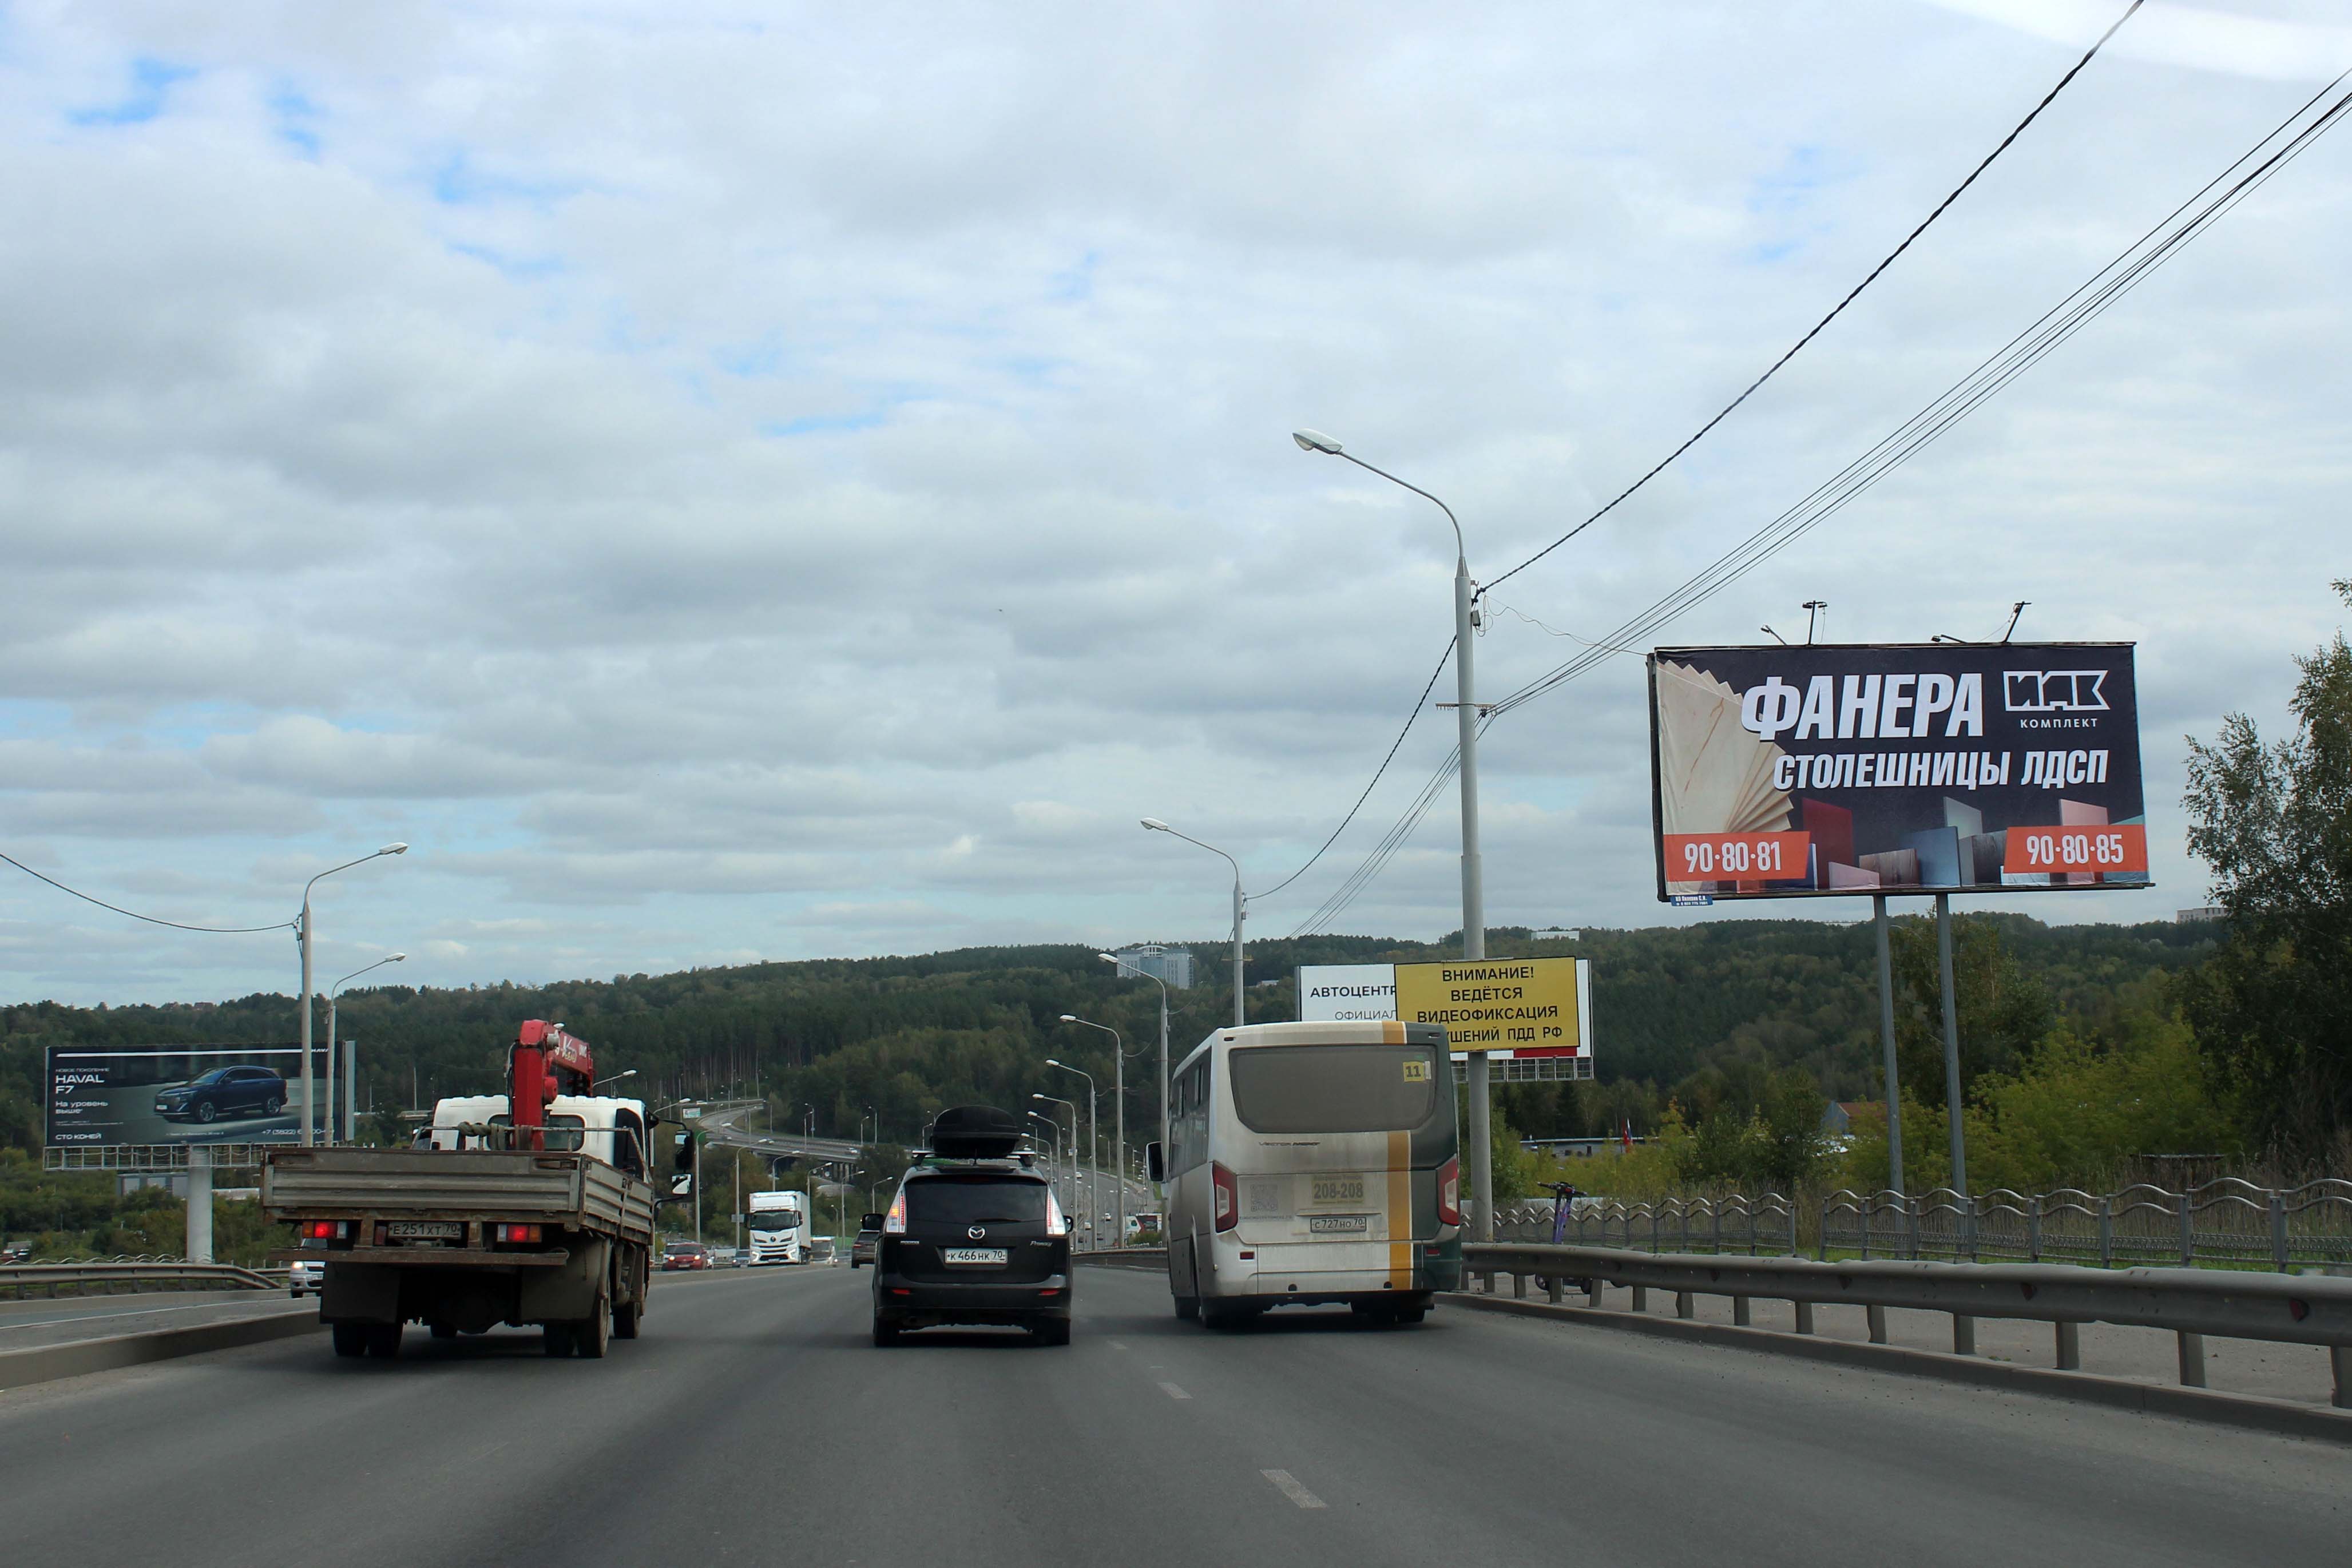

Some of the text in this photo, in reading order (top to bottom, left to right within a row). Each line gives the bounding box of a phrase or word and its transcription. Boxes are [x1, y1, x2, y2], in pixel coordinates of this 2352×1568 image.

[1741, 672, 1984, 741] ФАНЕРА
[2020, 718, 2097, 728] КОМПЛЕКТ
[1773, 749, 2109, 791] СТОЛЕШНИЦЫ ЛДСП
[1442, 967, 1534, 982] ВНИМАНИЕ!
[1451, 986, 1523, 1002] ВЕДЁТСЯ
[1417, 1006, 1558, 1023] ВИДЕОФИКСАЦИЯ
[1447, 1026, 1562, 1042] ШЕНИЙ ПДД РФ
[55, 1075, 105, 1083] HAVAL
[1405, 1065, 1421, 1077] 11
[55, 1085, 74, 1094] F7
[1314, 1182, 1363, 1200] 208-208
